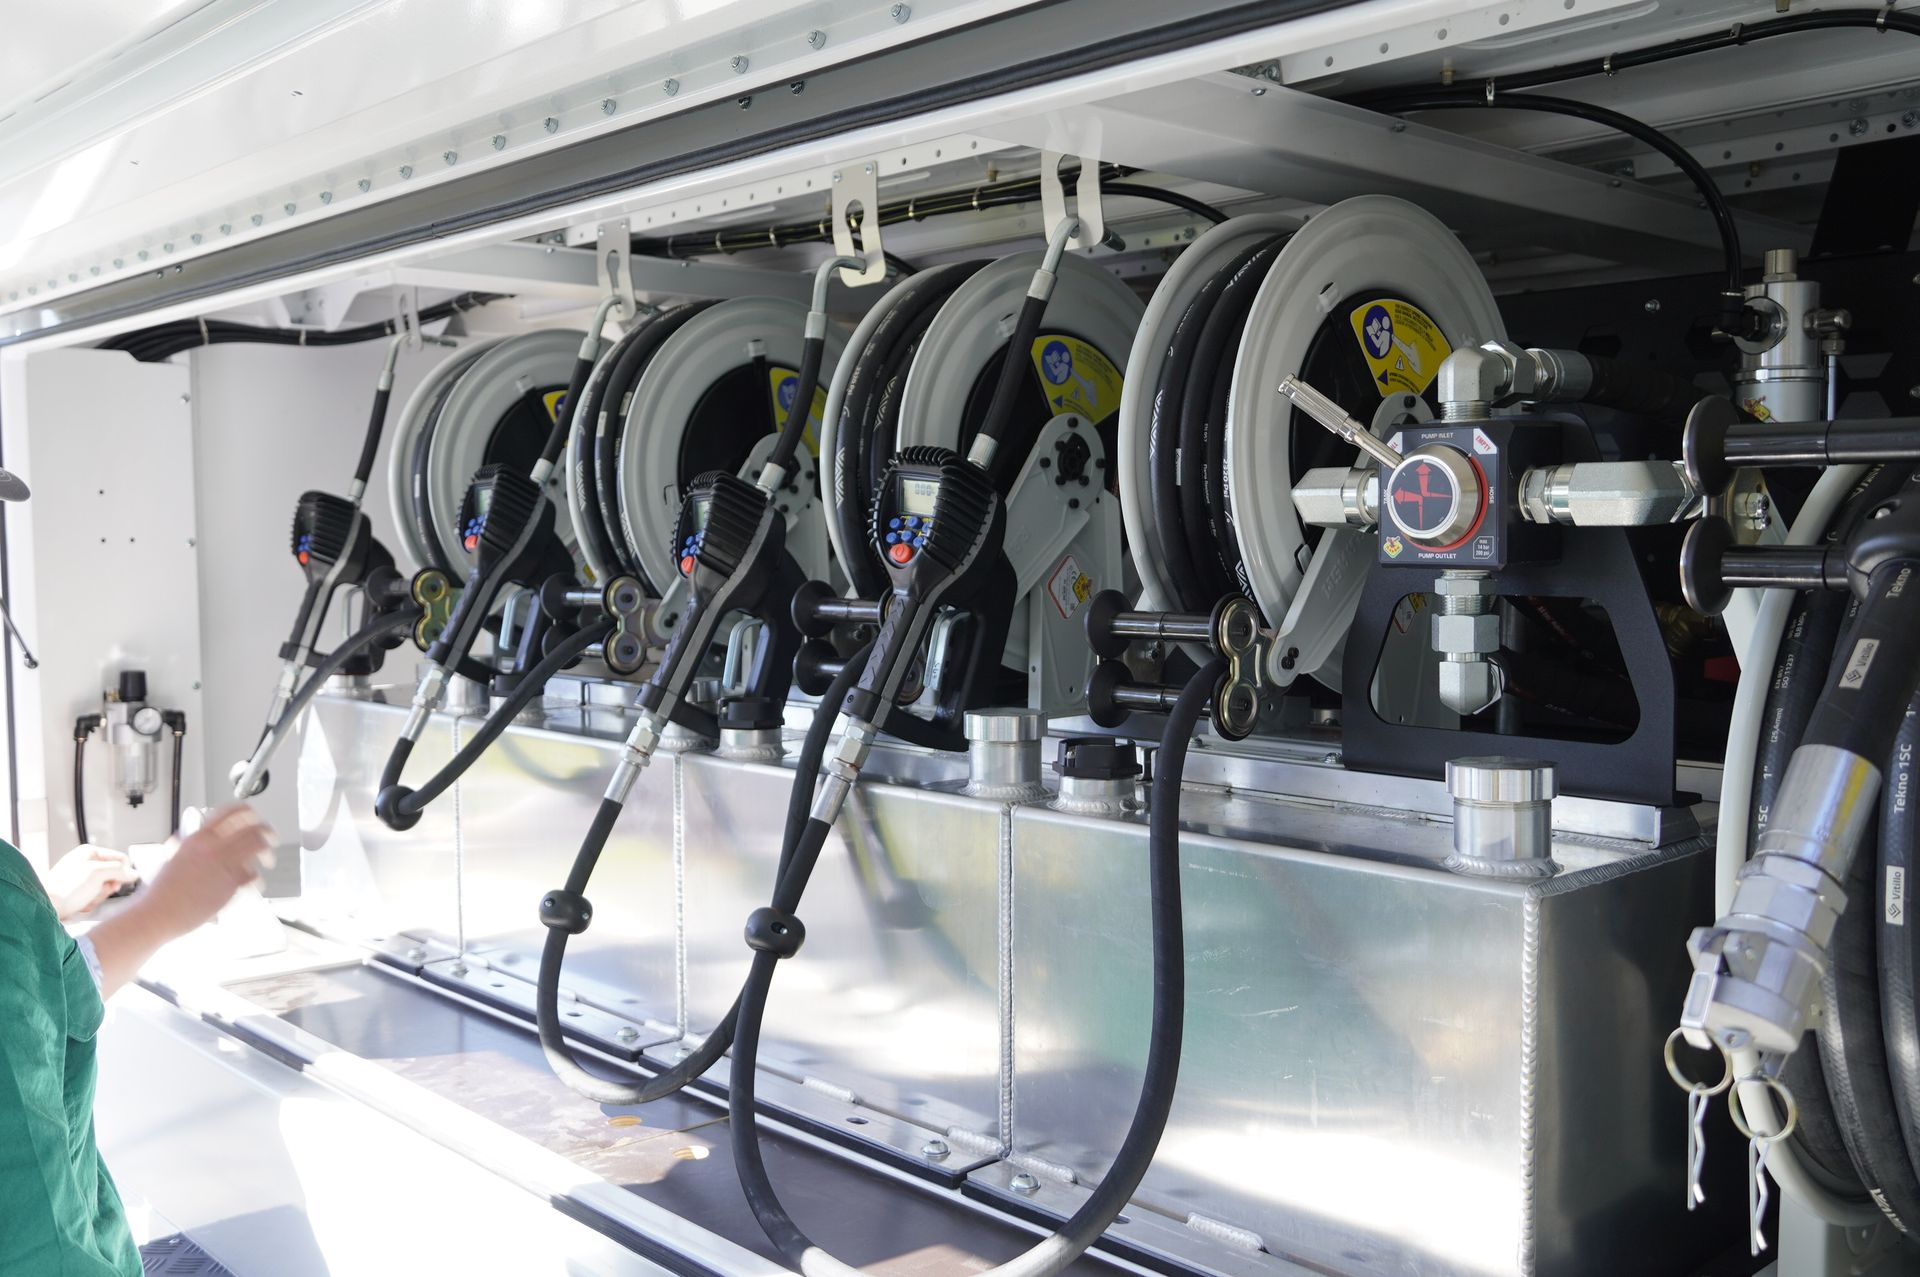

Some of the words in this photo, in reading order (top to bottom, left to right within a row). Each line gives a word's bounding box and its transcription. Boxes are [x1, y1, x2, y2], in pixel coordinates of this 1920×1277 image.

[1475, 435, 1491, 452] EMPTY
[1435, 552, 1457, 560] OUTLET
[1886, 567, 1911, 598] Tekno
[1784, 653, 1795, 675] 11237
[1856, 642, 1875, 667] Vitillo
[1781, 676, 1790, 689] ISO
[1898, 743, 1912, 768] 1SC
[1893, 772, 1909, 814] Tekno
[1757, 805, 1769, 830] 1SC
[1892, 871, 1902, 900] Vitillo
